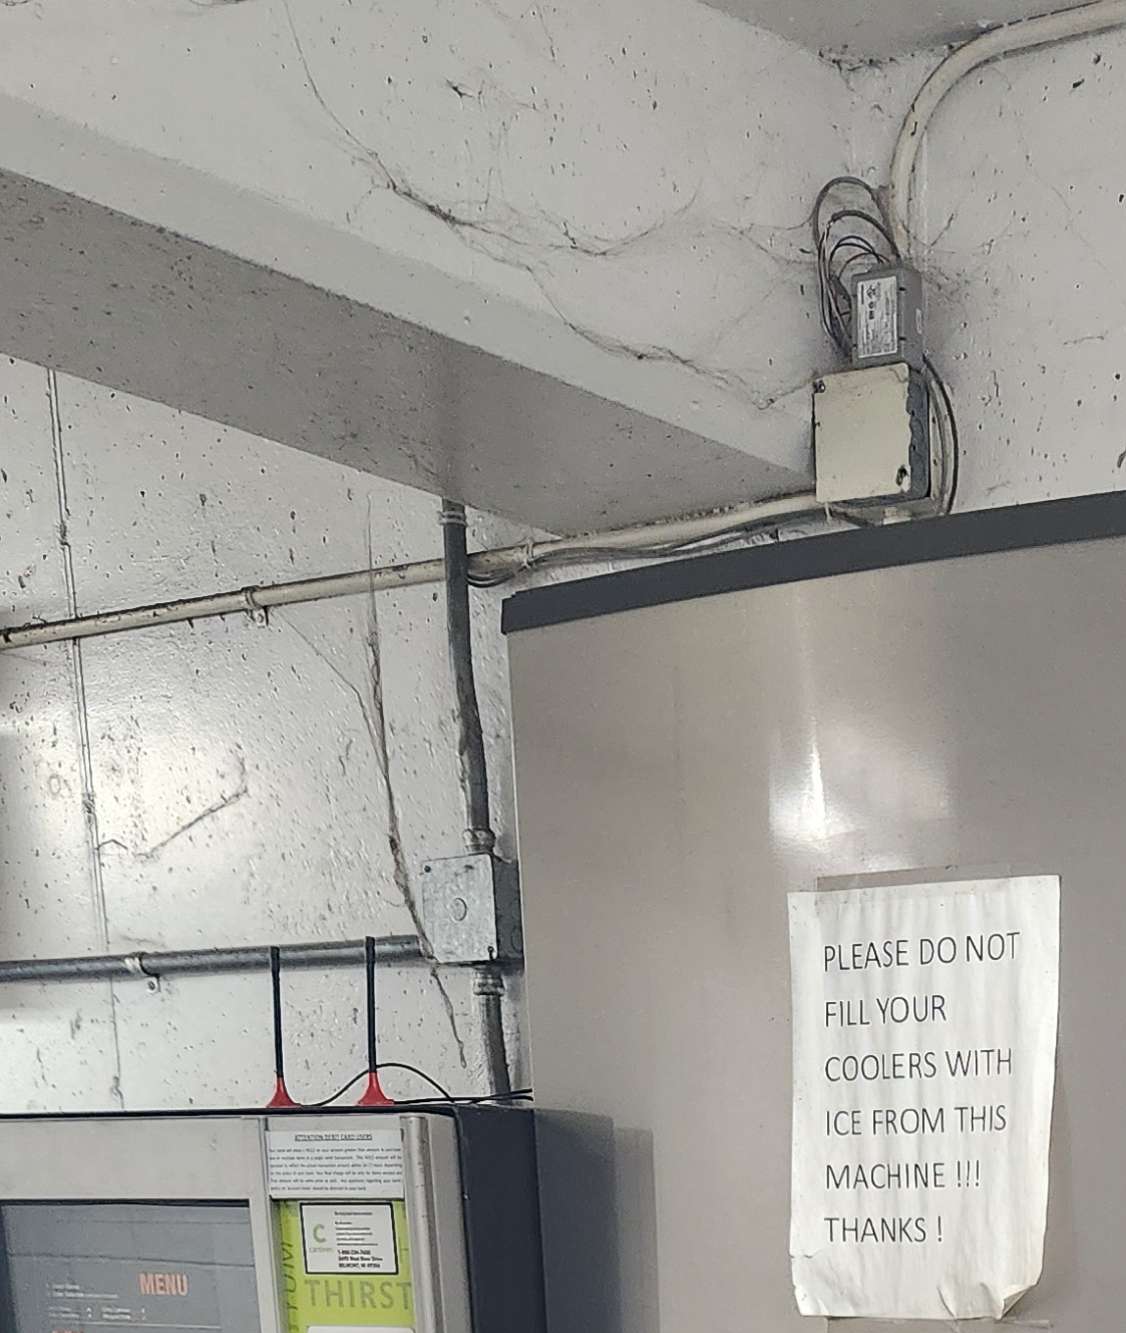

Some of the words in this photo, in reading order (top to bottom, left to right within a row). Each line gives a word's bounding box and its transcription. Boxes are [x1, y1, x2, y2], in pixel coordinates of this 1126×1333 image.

[824, 939, 909, 972] PLEASE
[920, 936, 957, 966] DO
[966, 931, 1020, 963] NOT
[825, 1000, 870, 1027] FILL
[876, 994, 947, 1024] YOUR
[824, 1051, 937, 1082] COOLERS
[945, 1048, 1012, 1077] WITH
[826, 1110, 861, 1136] ICE
[873, 1108, 945, 1135] FROM
[954, 1104, 1007, 1133] THIS
[825, 1162, 945, 1190] MACHINE
[957, 1160, 980, 1188] !!!
[824, 1216, 926, 1243] THANKS
[938, 1216, 943, 1242] !
[138, 1272, 188, 1297] MENU
[305, 1280, 412, 1310] THIRST
